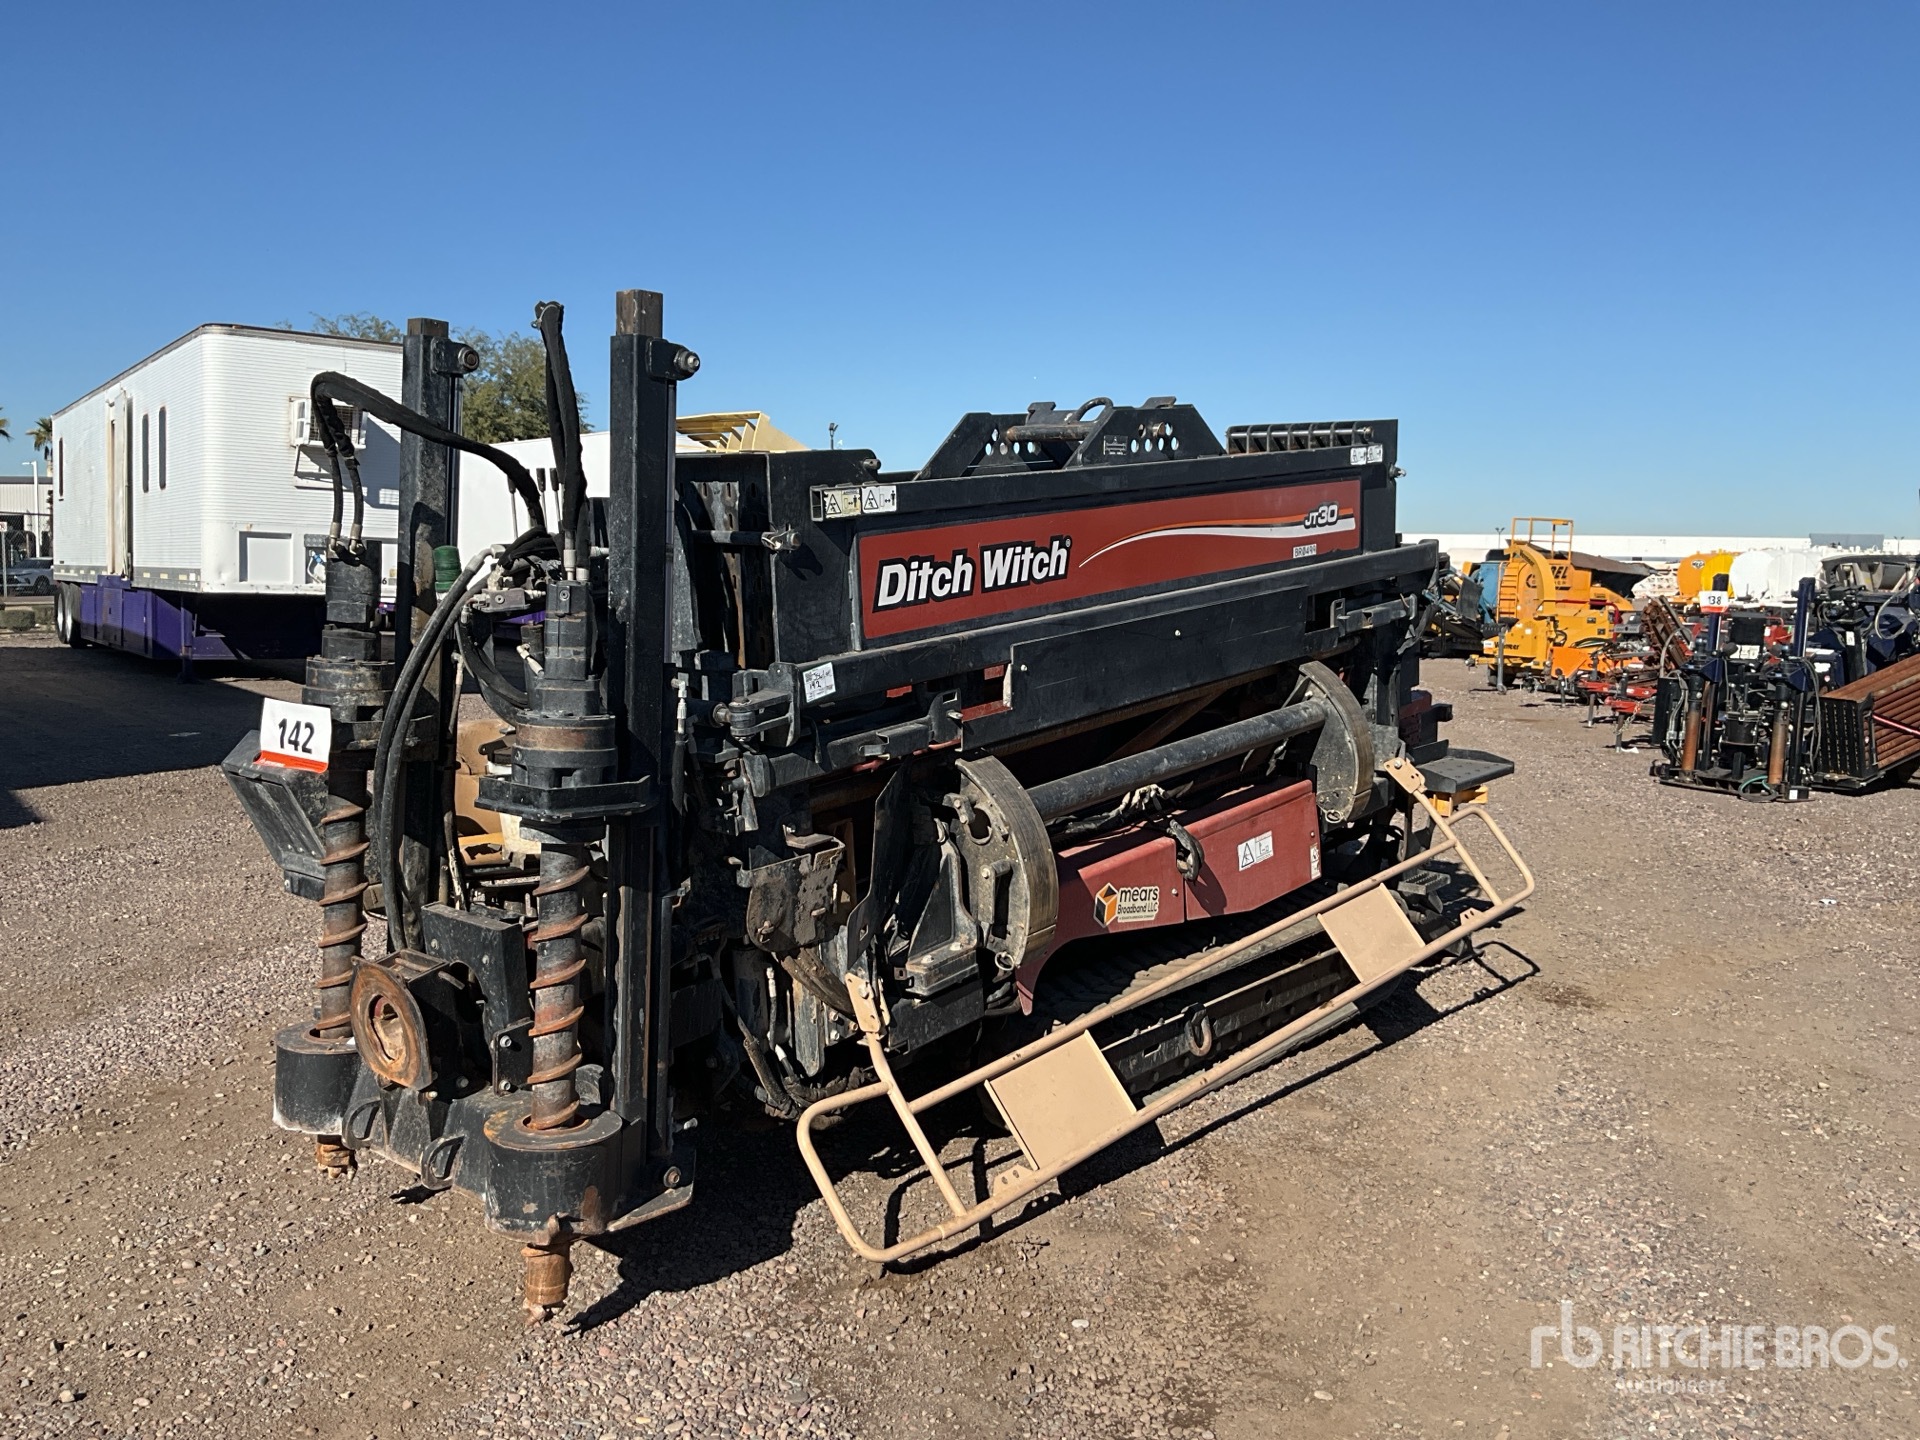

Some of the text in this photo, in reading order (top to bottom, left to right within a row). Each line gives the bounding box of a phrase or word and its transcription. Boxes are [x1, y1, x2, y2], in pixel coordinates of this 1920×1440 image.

[1304, 504, 1338, 527] JT30
[877, 553, 974, 608] Ditch
[278, 717, 316, 755] 142
[1119, 888, 1159, 903] mears
[1117, 902, 1158, 915] Broadband LLC
